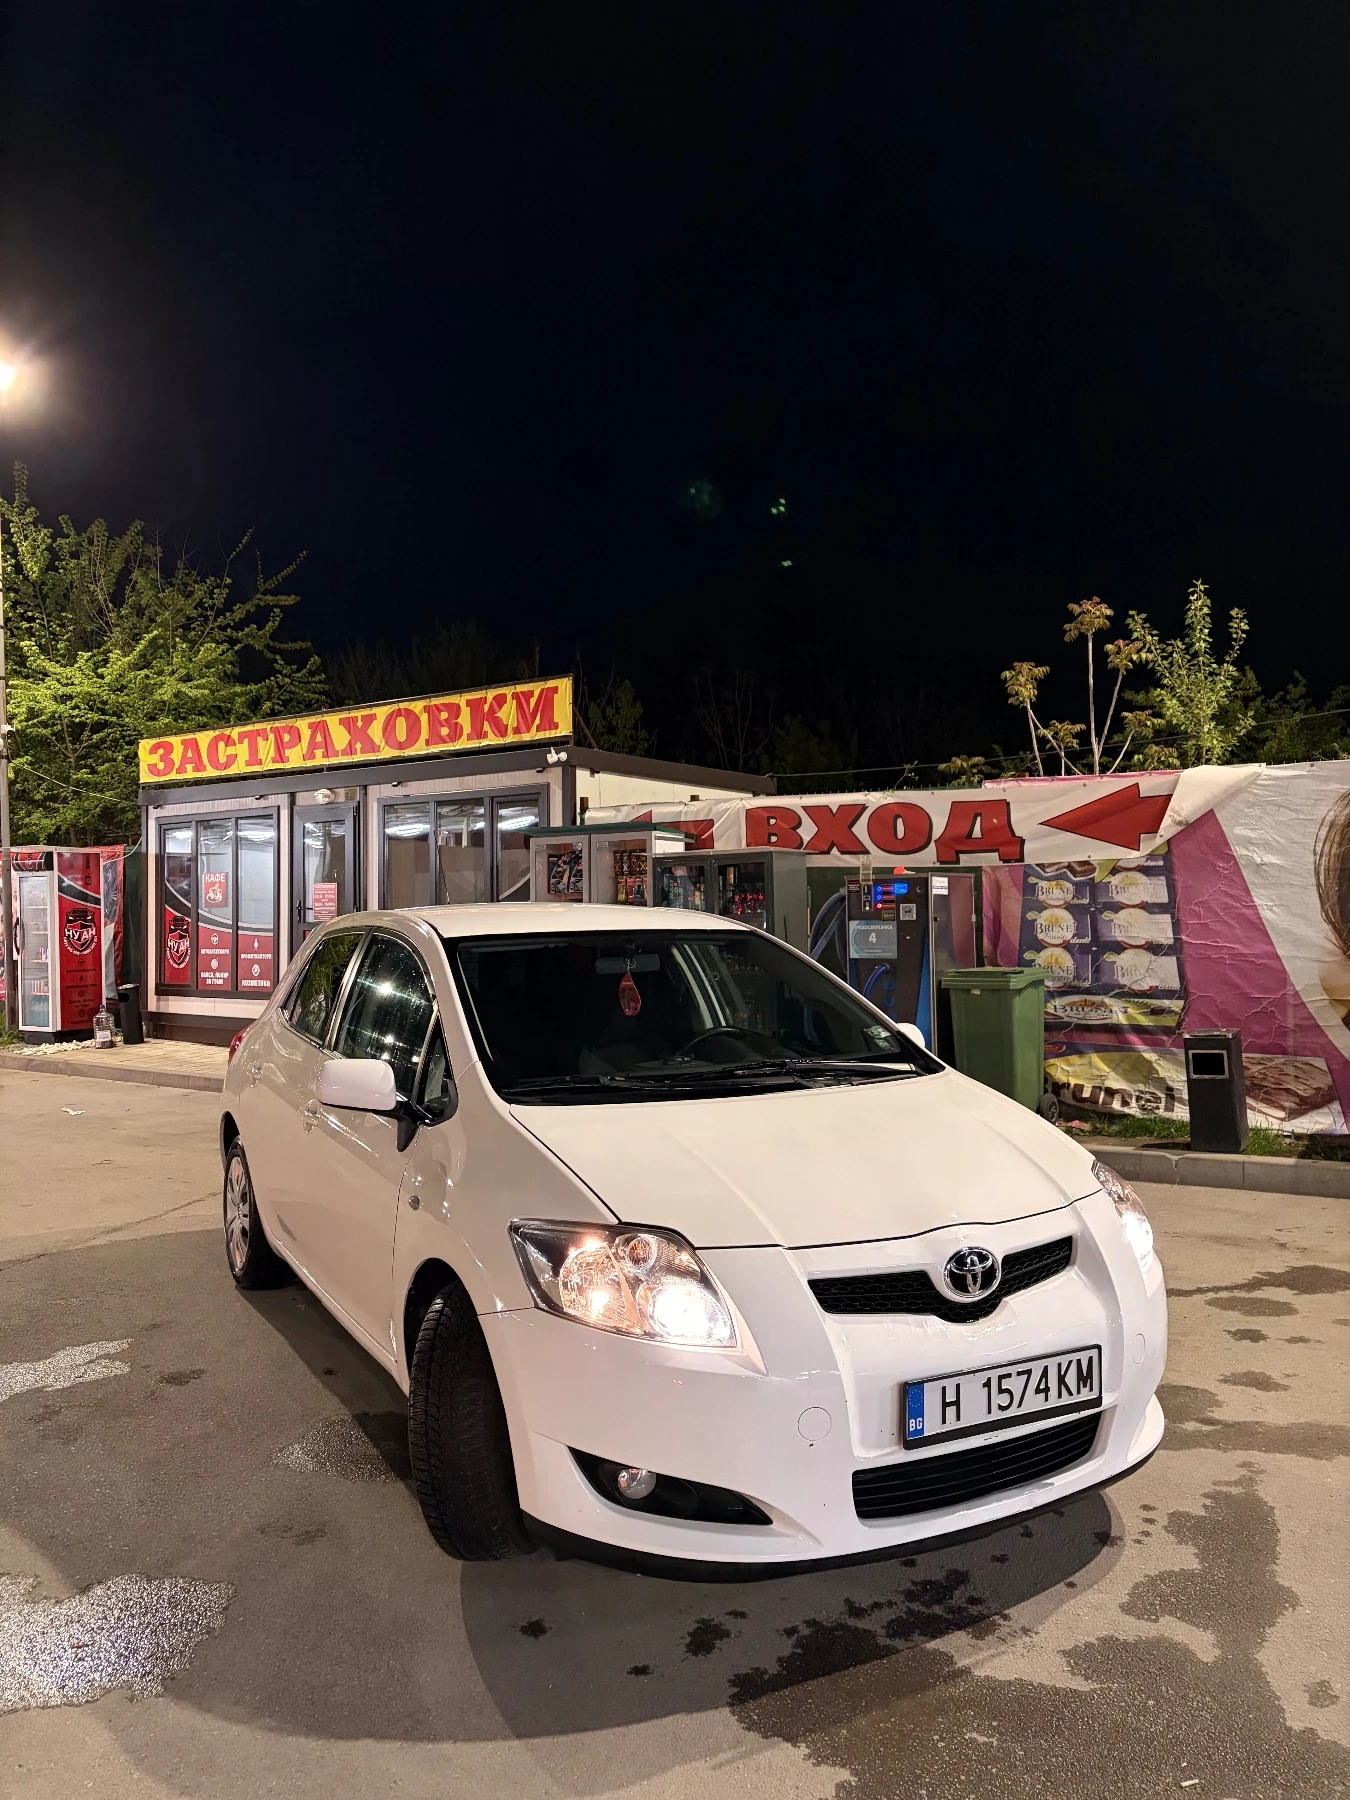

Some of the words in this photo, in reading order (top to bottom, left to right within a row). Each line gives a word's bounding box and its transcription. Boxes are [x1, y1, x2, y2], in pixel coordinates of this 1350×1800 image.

[147, 685, 560, 778] ЗАСТРАХОВКИ
[745, 798, 1026, 866] ВХОД
[205, 873, 226, 883] КАФЕ
[868, 932, 877, 944] 4
[909, 1417, 923, 1432] BG
